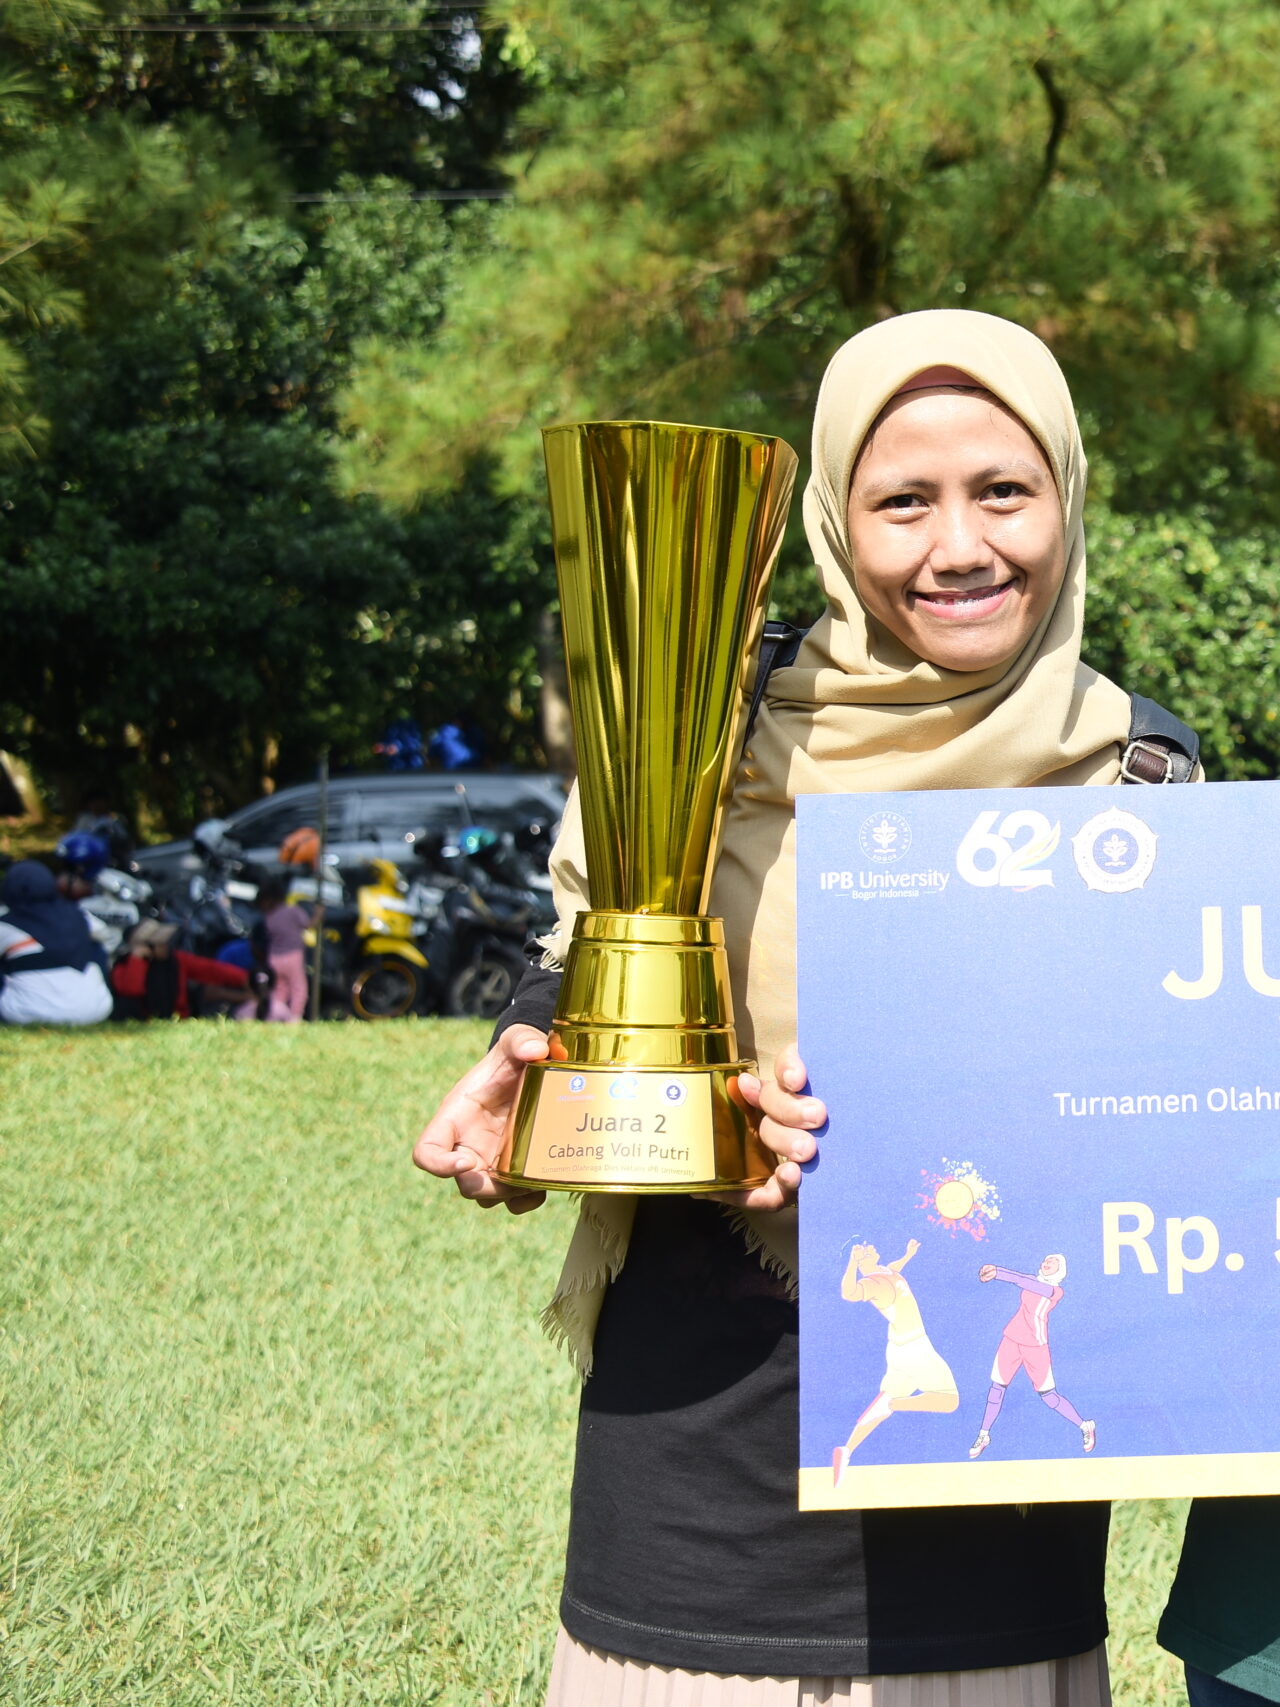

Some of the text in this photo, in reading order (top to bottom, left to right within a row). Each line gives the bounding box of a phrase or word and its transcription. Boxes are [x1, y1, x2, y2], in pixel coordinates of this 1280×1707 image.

[956, 809, 1061, 893] 62
[820, 869, 950, 892] IPB University
[852, 887, 919, 901] Bogor Indonesia
[1053, 1092, 1198, 1117] Turnamen
[576, 1113, 667, 1134] Juara 2
[548, 1142, 690, 1161] Cabang Voli Putri
[1102, 1201, 1245, 1295] Rp.
